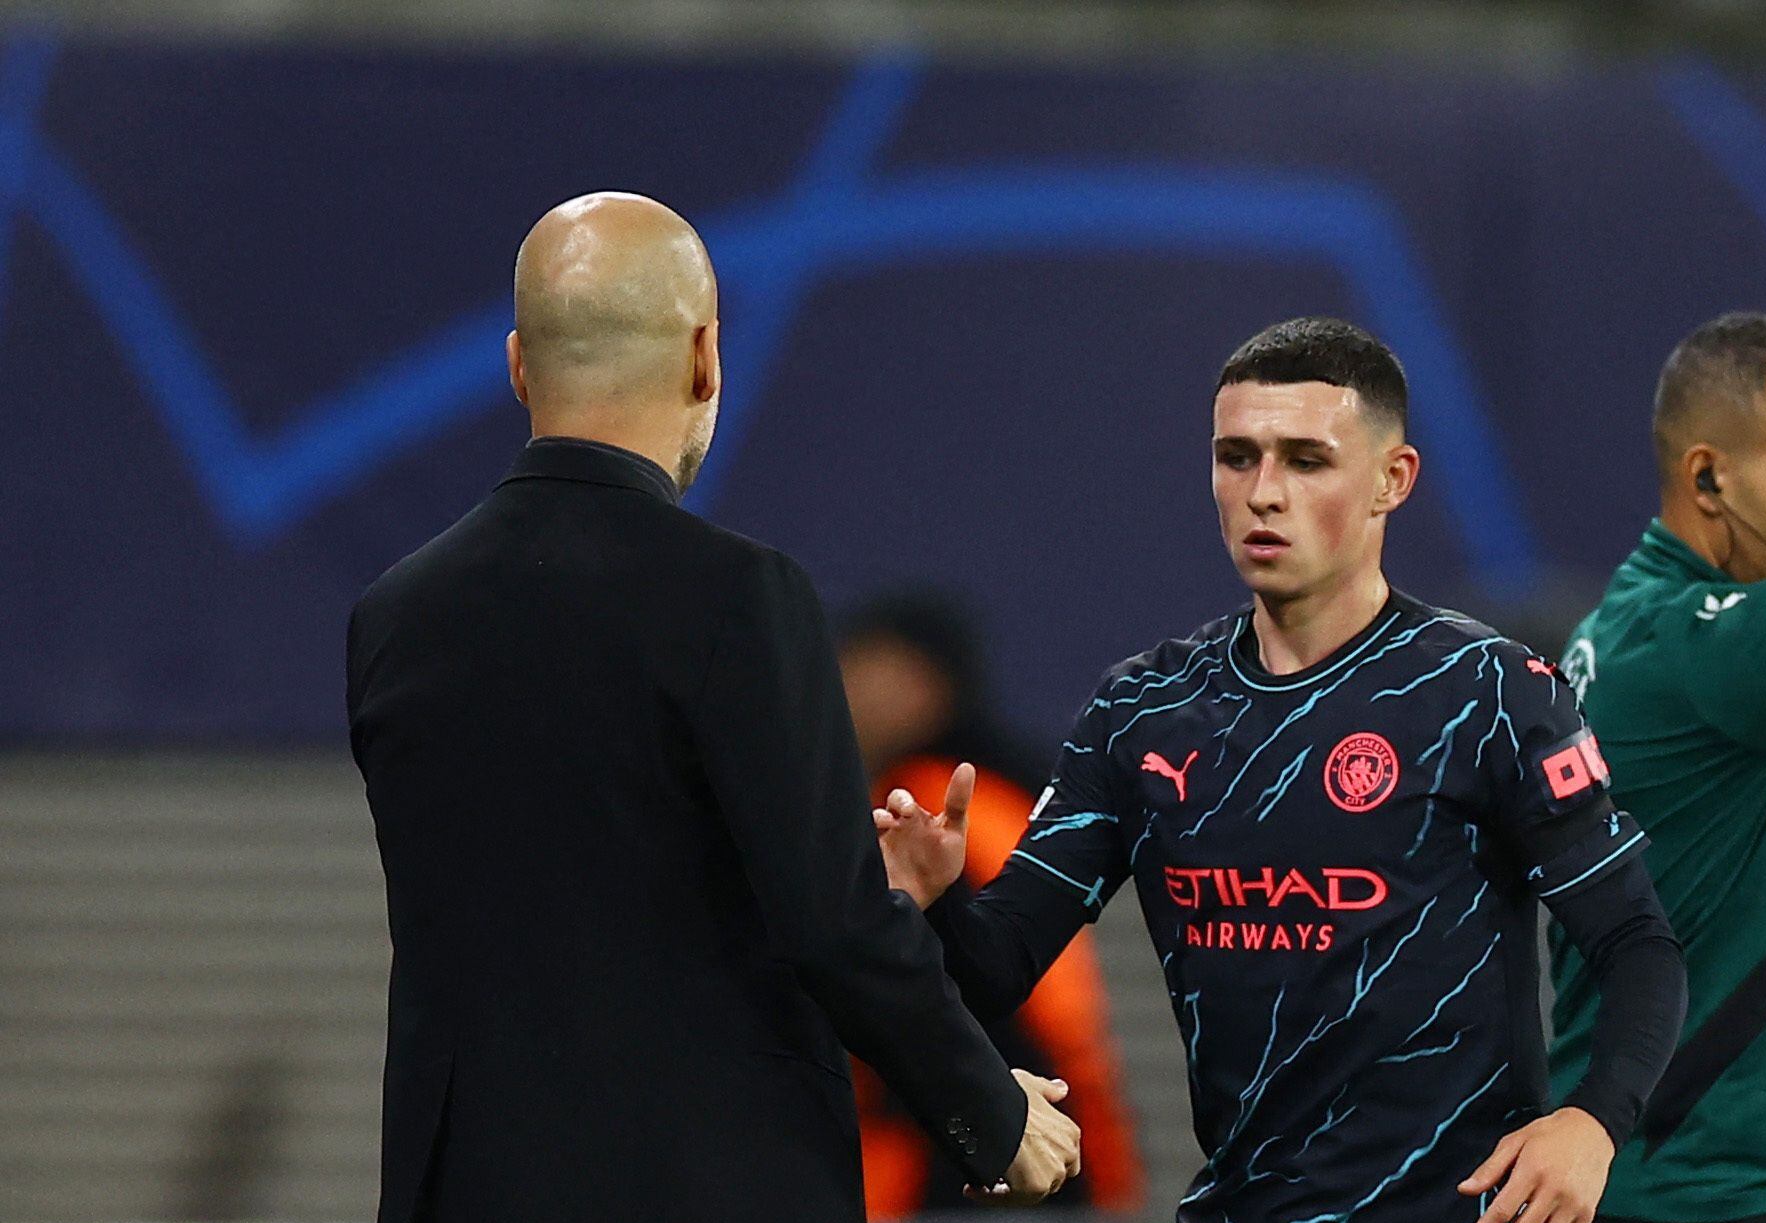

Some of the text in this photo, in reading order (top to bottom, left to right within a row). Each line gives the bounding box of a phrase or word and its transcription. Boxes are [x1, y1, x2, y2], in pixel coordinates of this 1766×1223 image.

[1345, 795, 1366, 806] CITY
[1164, 866, 1389, 910] ETIHAD
[1187, 921, 1335, 952] AIRWAYS
